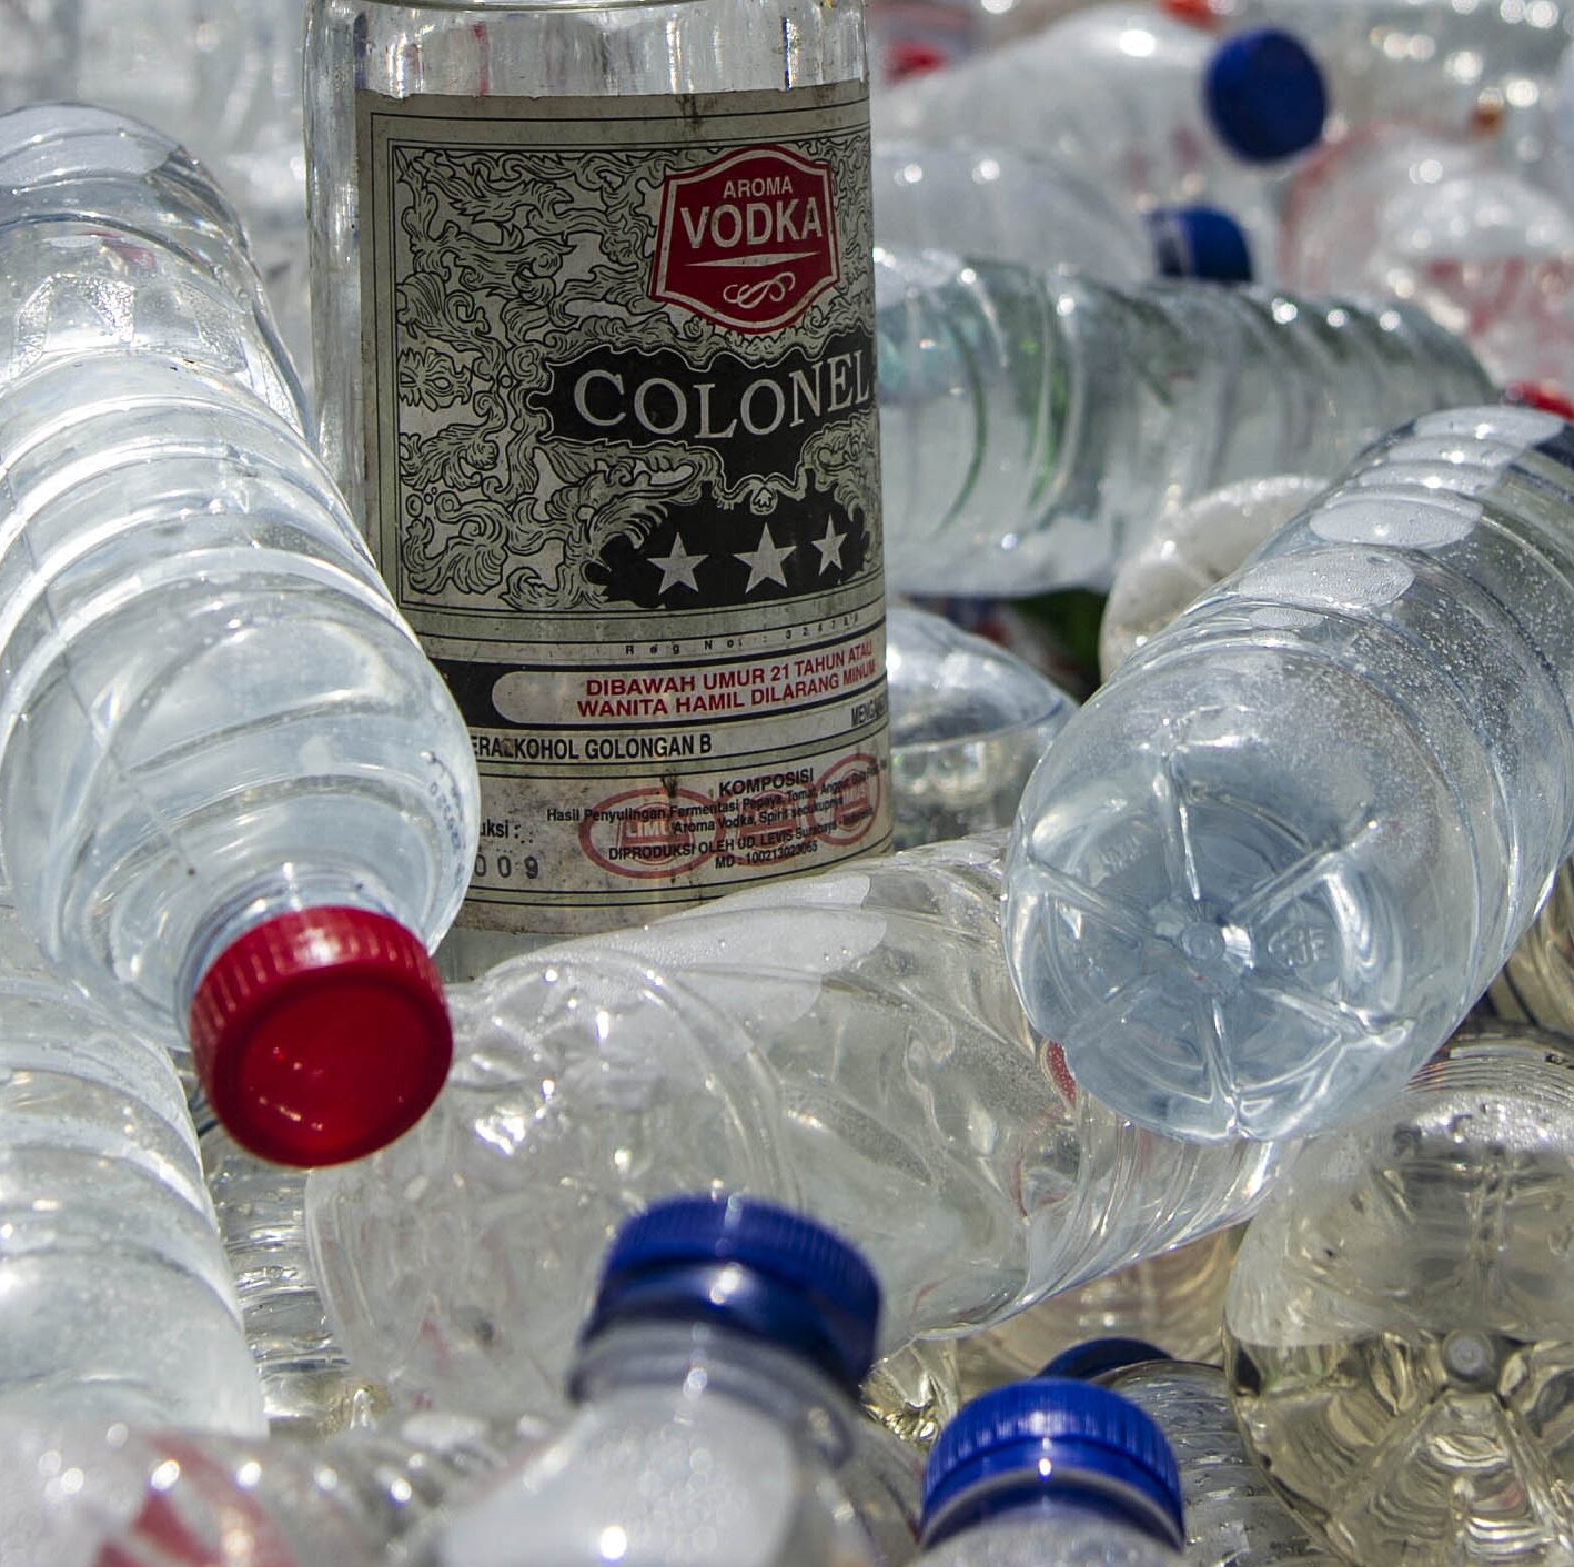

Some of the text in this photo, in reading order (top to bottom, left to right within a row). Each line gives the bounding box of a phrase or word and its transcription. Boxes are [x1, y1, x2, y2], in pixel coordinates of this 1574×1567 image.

[723, 176, 794, 198] AROMA
[680, 196, 823, 249] VODKA
[574, 349, 870, 439] COLONEL
[586, 638, 872, 697] DIBAWAH UMUR 21 TAHUN ATAU
[577, 659, 876, 718] WANITA HAMIL DILARANG MINUM
[585, 734, 695, 760] GOLONGAN
[700, 733, 713, 754] B
[718, 767, 814, 798] KOMPOSISI
[547, 808, 579, 822] Hasil
[608, 842, 695, 861] DIPRODUKSI
[698, 838, 735, 854] OLEH
